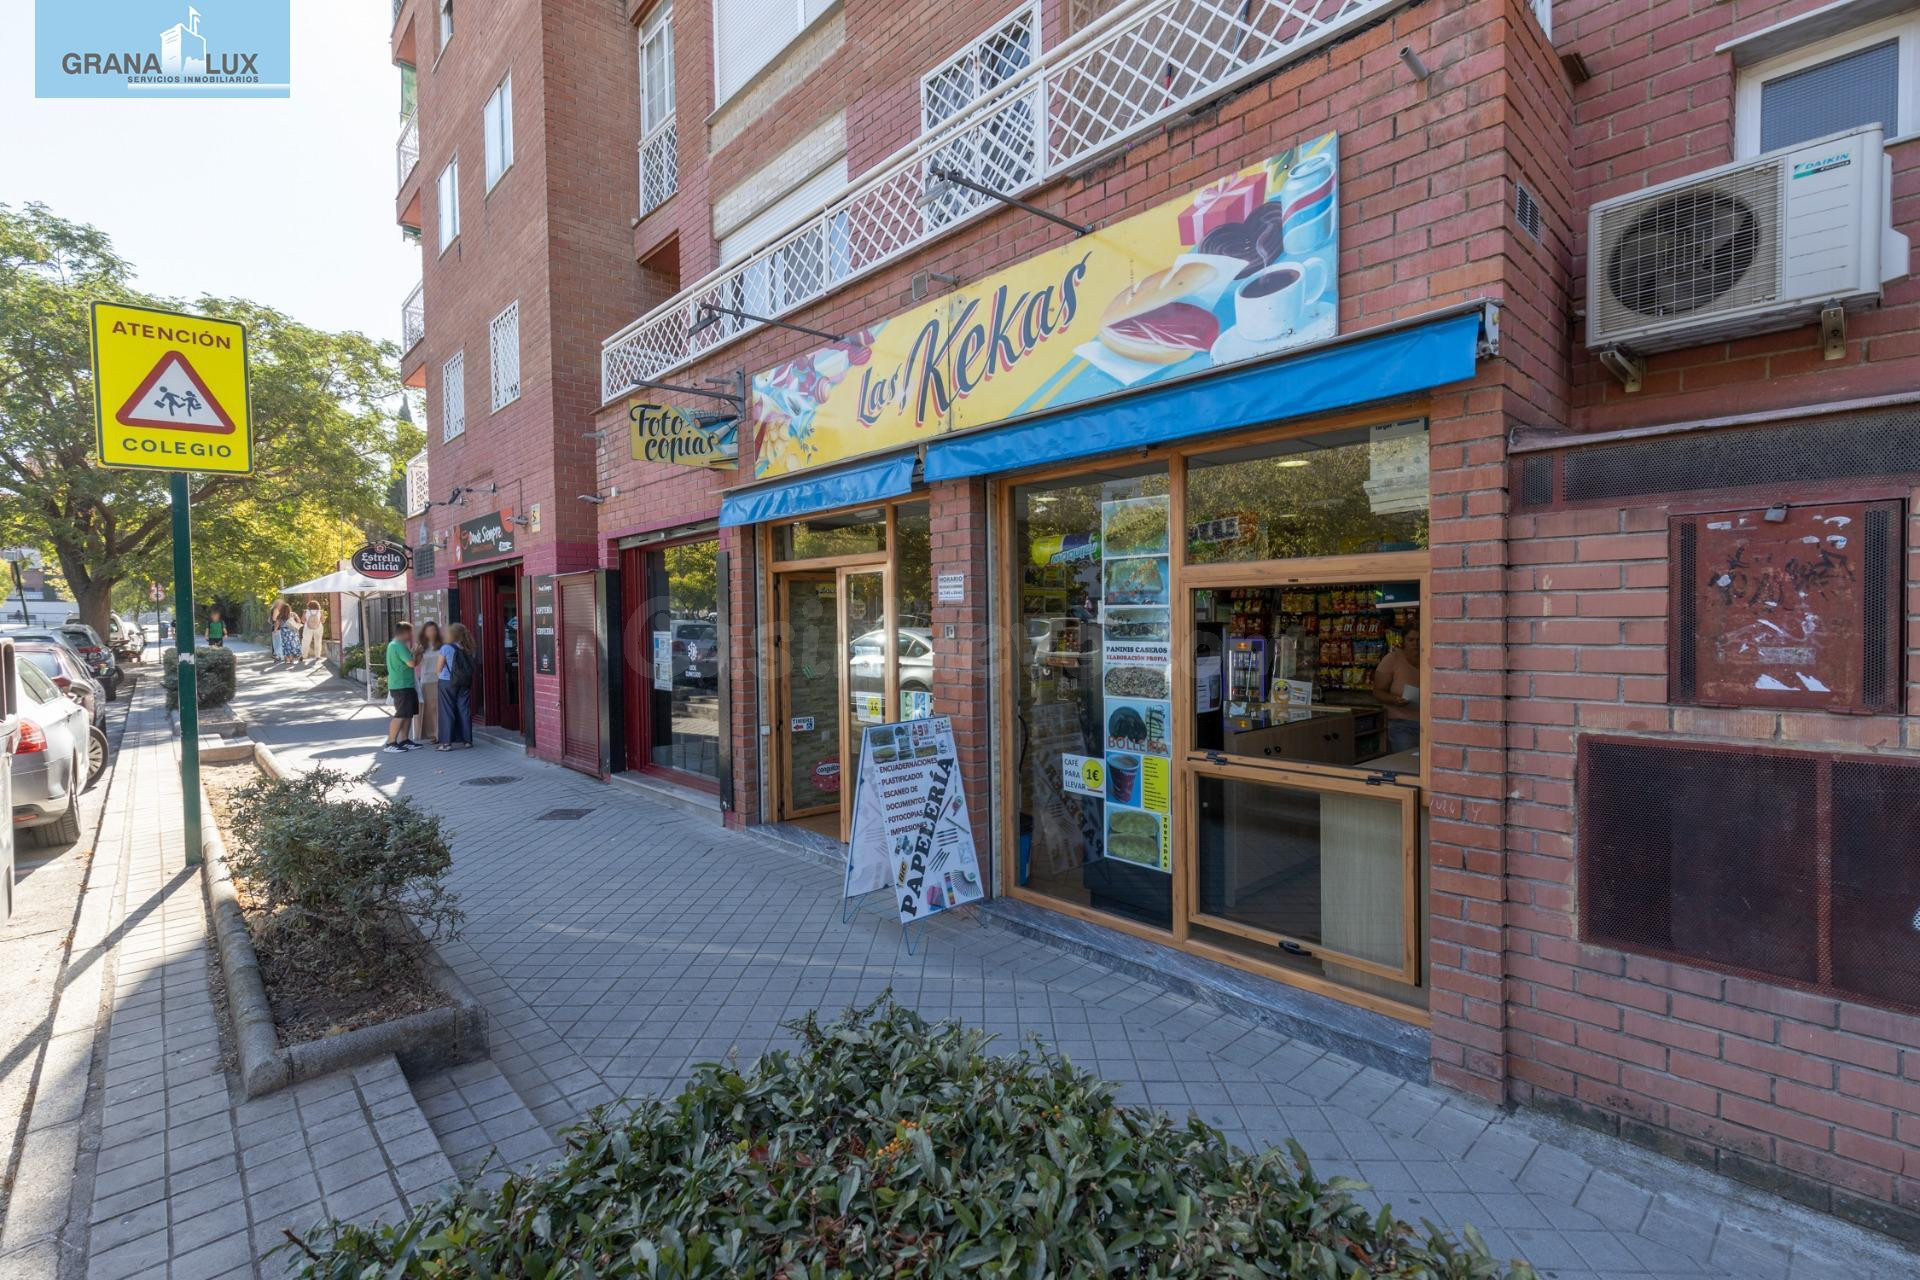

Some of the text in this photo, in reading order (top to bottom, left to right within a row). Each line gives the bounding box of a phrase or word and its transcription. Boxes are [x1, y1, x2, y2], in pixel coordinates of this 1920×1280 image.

[1805, 151, 1850, 169] DAIKIN
[112, 320, 231, 350] ATENCIÓN
[899, 250, 1093, 427] Kekas
[629, 403, 685, 437] Foto
[122, 437, 232, 458] COLEGIO
[644, 430, 720, 464] copias
[361, 552, 401, 563] Estrella
[362, 561, 400, 571] Galicia
[792, 716, 814, 725] TIMBRE
[879, 757, 938, 774] ENCUADERNACIONES
[881, 772, 924, 786] PLASTIFICADOS
[1064, 769, 1081, 779] PARA
[1086, 768, 1100, 782] 1€
[884, 785, 918, 798] ESCANEO DE
[1064, 780, 1087, 790] LLEVAR
[886, 796, 926, 811] DOCUMENTOS
[890, 821, 928, 836] IMPRESIONES
[901, 757, 955, 917] PAPELERÍA
